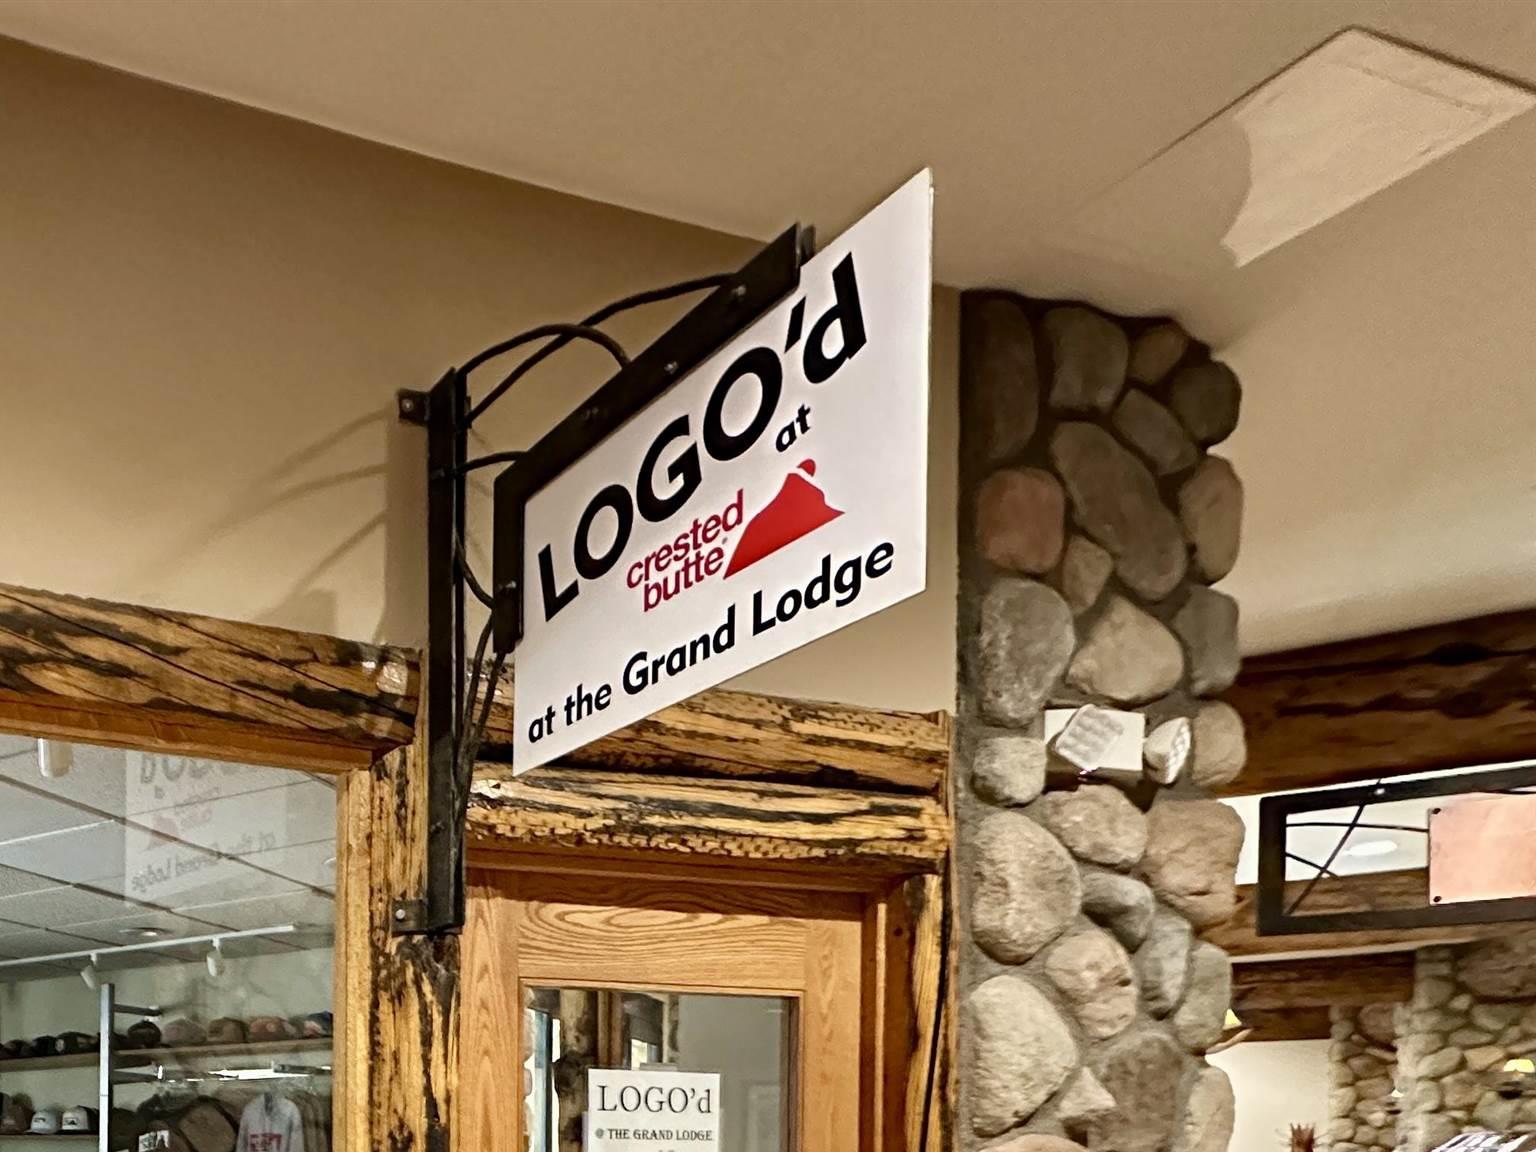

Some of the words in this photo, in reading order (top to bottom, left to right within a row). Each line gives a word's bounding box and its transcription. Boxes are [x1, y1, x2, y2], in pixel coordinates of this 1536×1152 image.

[538, 252, 868, 622] LOGO'd
[775, 404, 811, 453] at
[626, 488, 744, 589] crested
[643, 546, 725, 613] butte
[528, 705, 556, 743] at
[564, 683, 613, 727] the
[622, 602, 737, 696] Grand
[752, 541, 895, 637] Lodge
[597, 1085, 712, 1114] LOGO'd
[608, 1128, 630, 1140] THE
[633, 1129, 673, 1141] GRAND
[676, 1130, 713, 1141] LODGE
